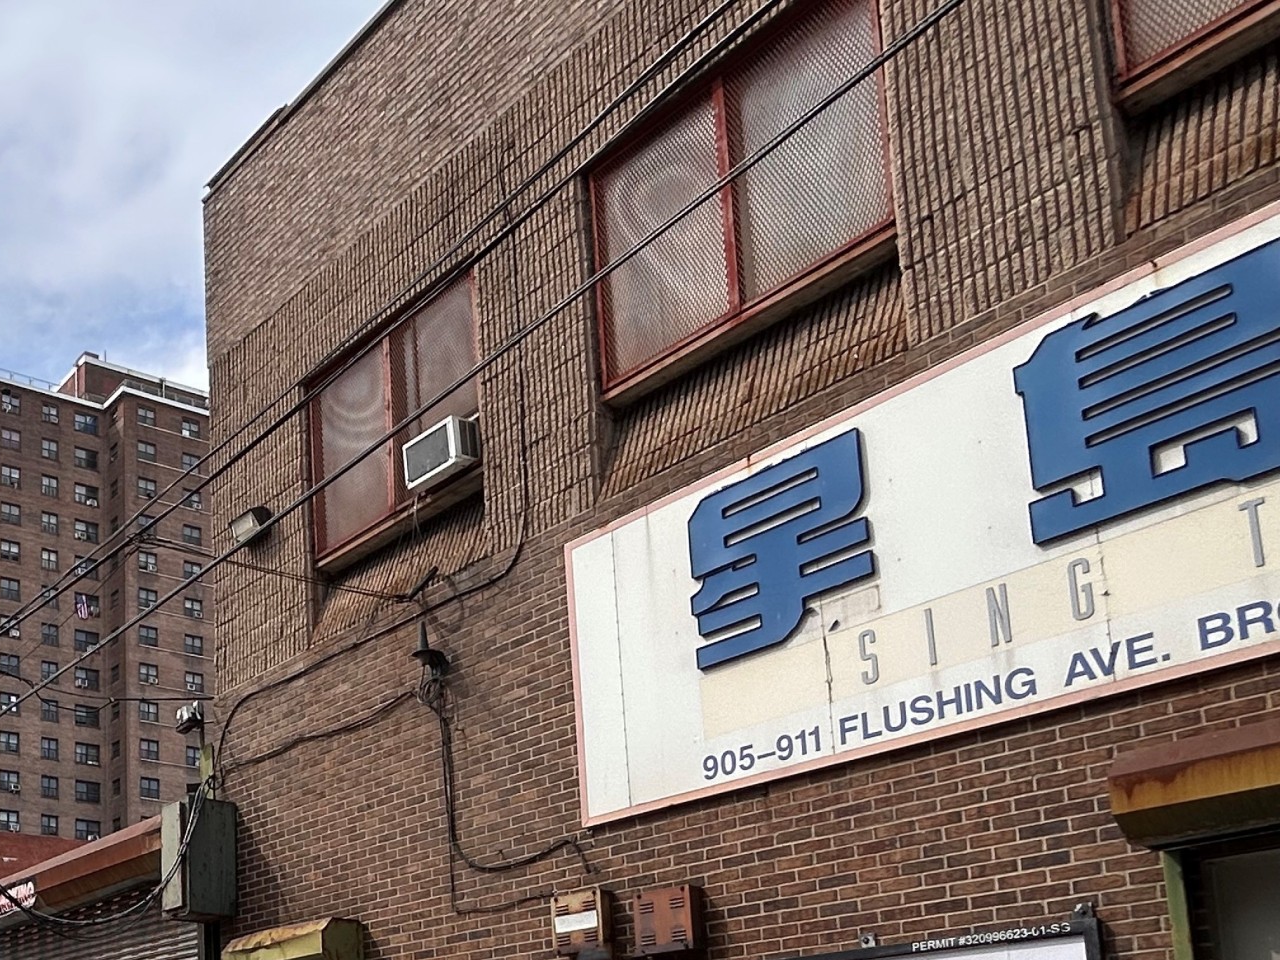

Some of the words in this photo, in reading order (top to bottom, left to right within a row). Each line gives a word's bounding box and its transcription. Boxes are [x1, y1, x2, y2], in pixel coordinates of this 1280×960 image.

[839, 666, 1037, 745] FLUSHING
[1064, 633, 1171, 687] AVE.
[1197, 600, 1280, 651] BR
[859, 556, 1094, 685] SING
[912, 936, 956, 952] PERMIT
